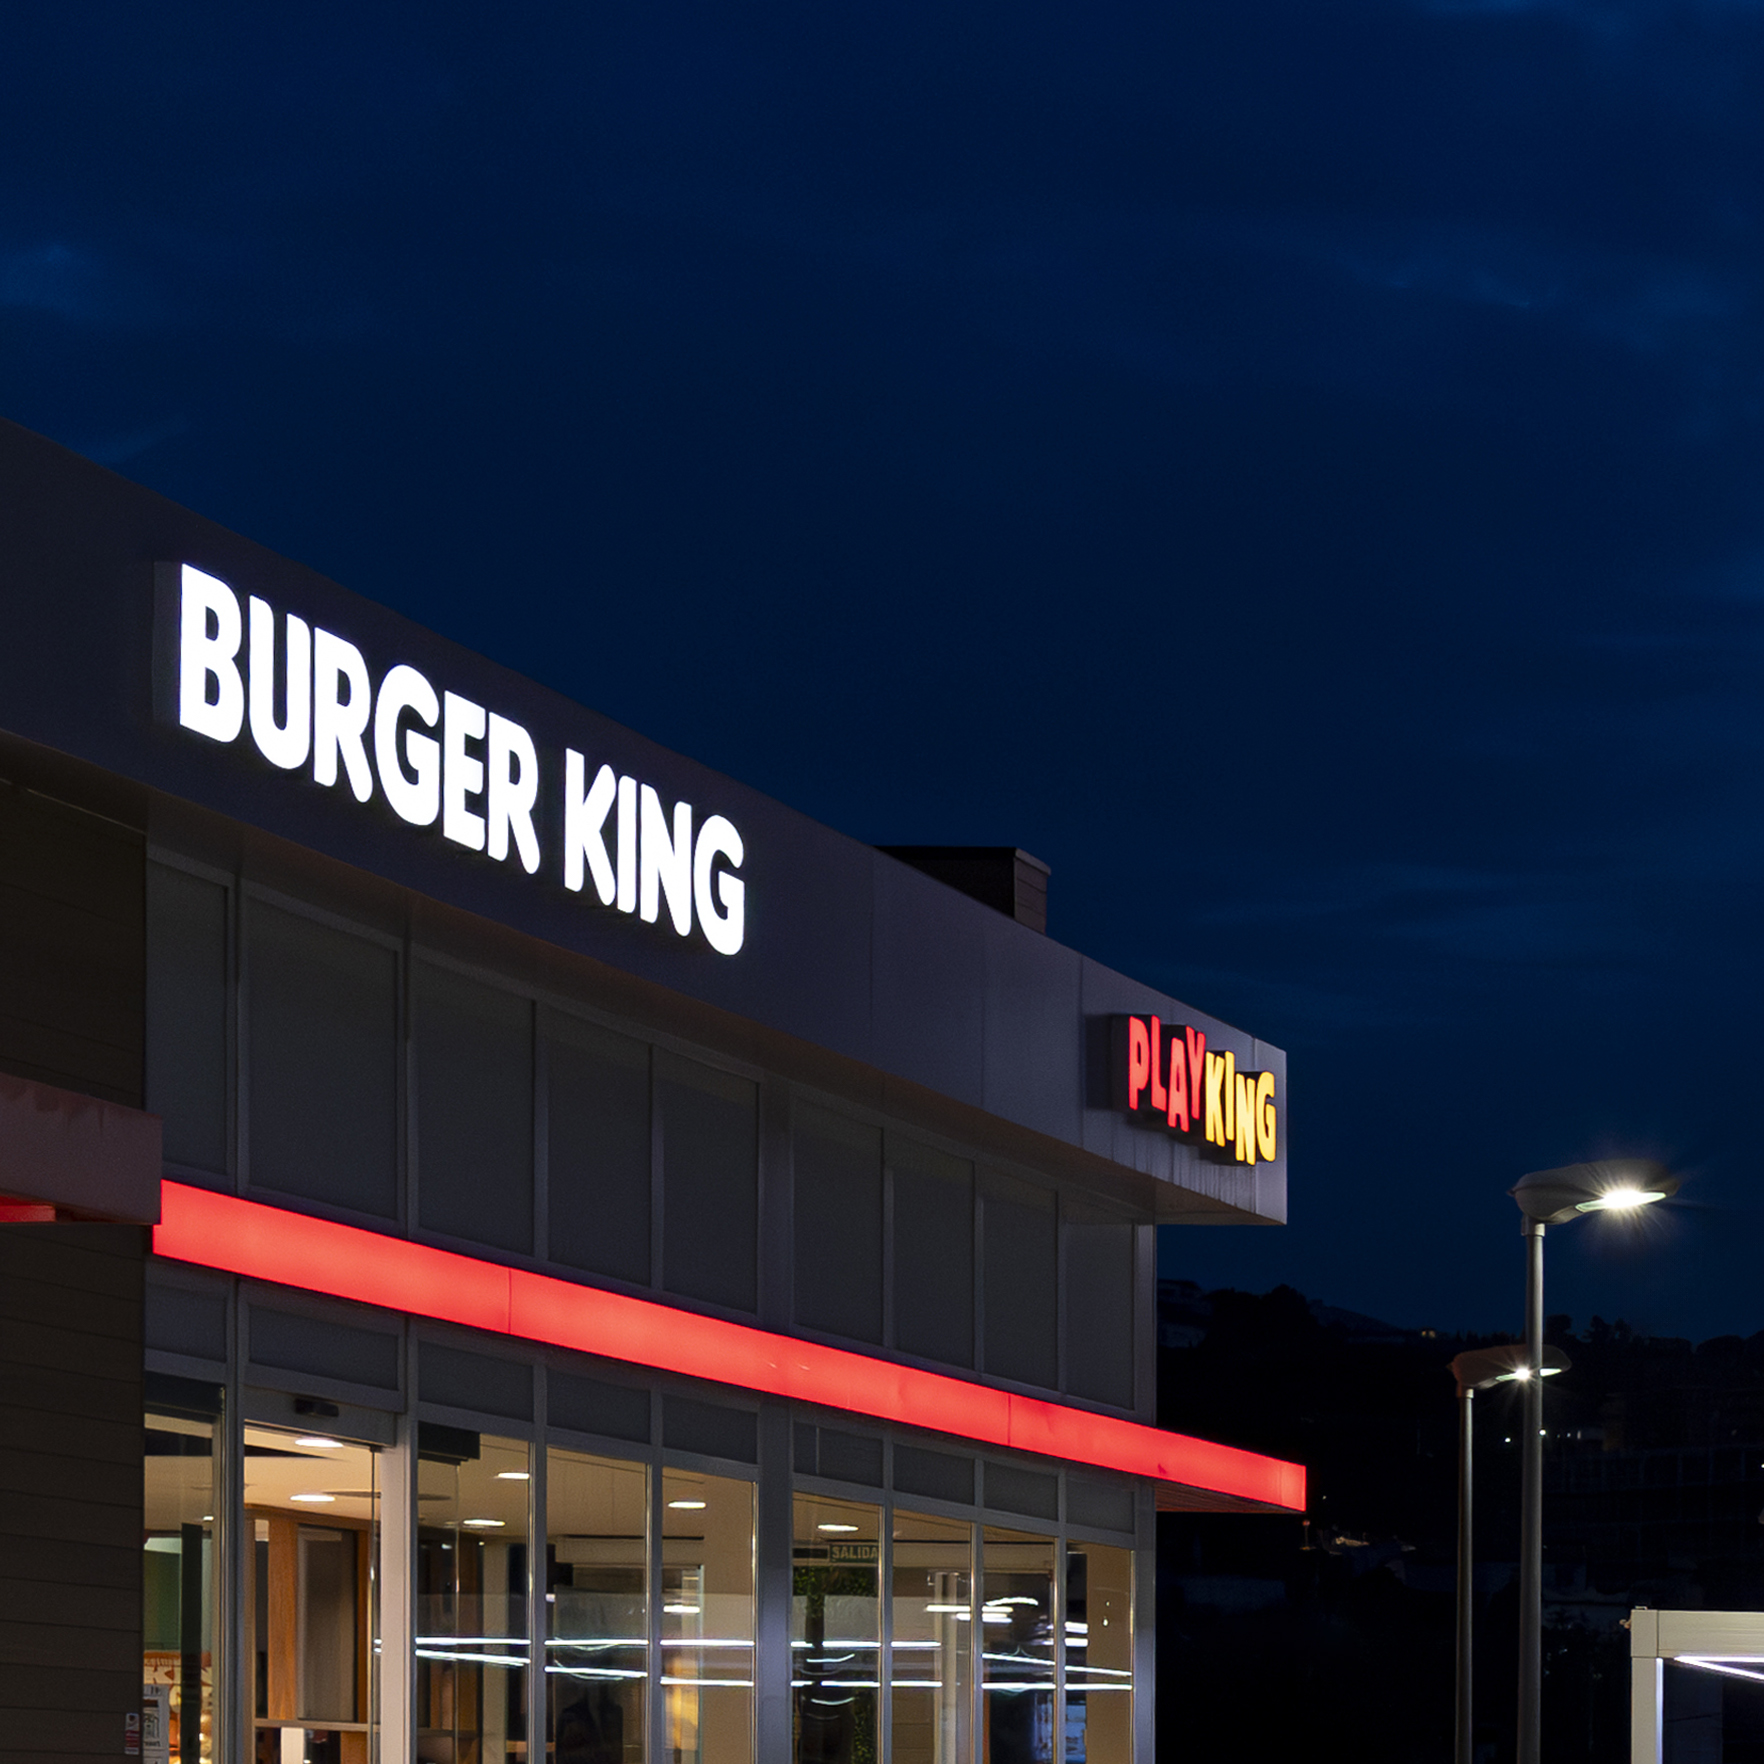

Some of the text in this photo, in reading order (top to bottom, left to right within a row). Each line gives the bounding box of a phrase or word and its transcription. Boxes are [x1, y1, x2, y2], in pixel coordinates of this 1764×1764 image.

[179, 563, 746, 956] BURGER KING
[832, 1546, 877, 1559] SALIDA
